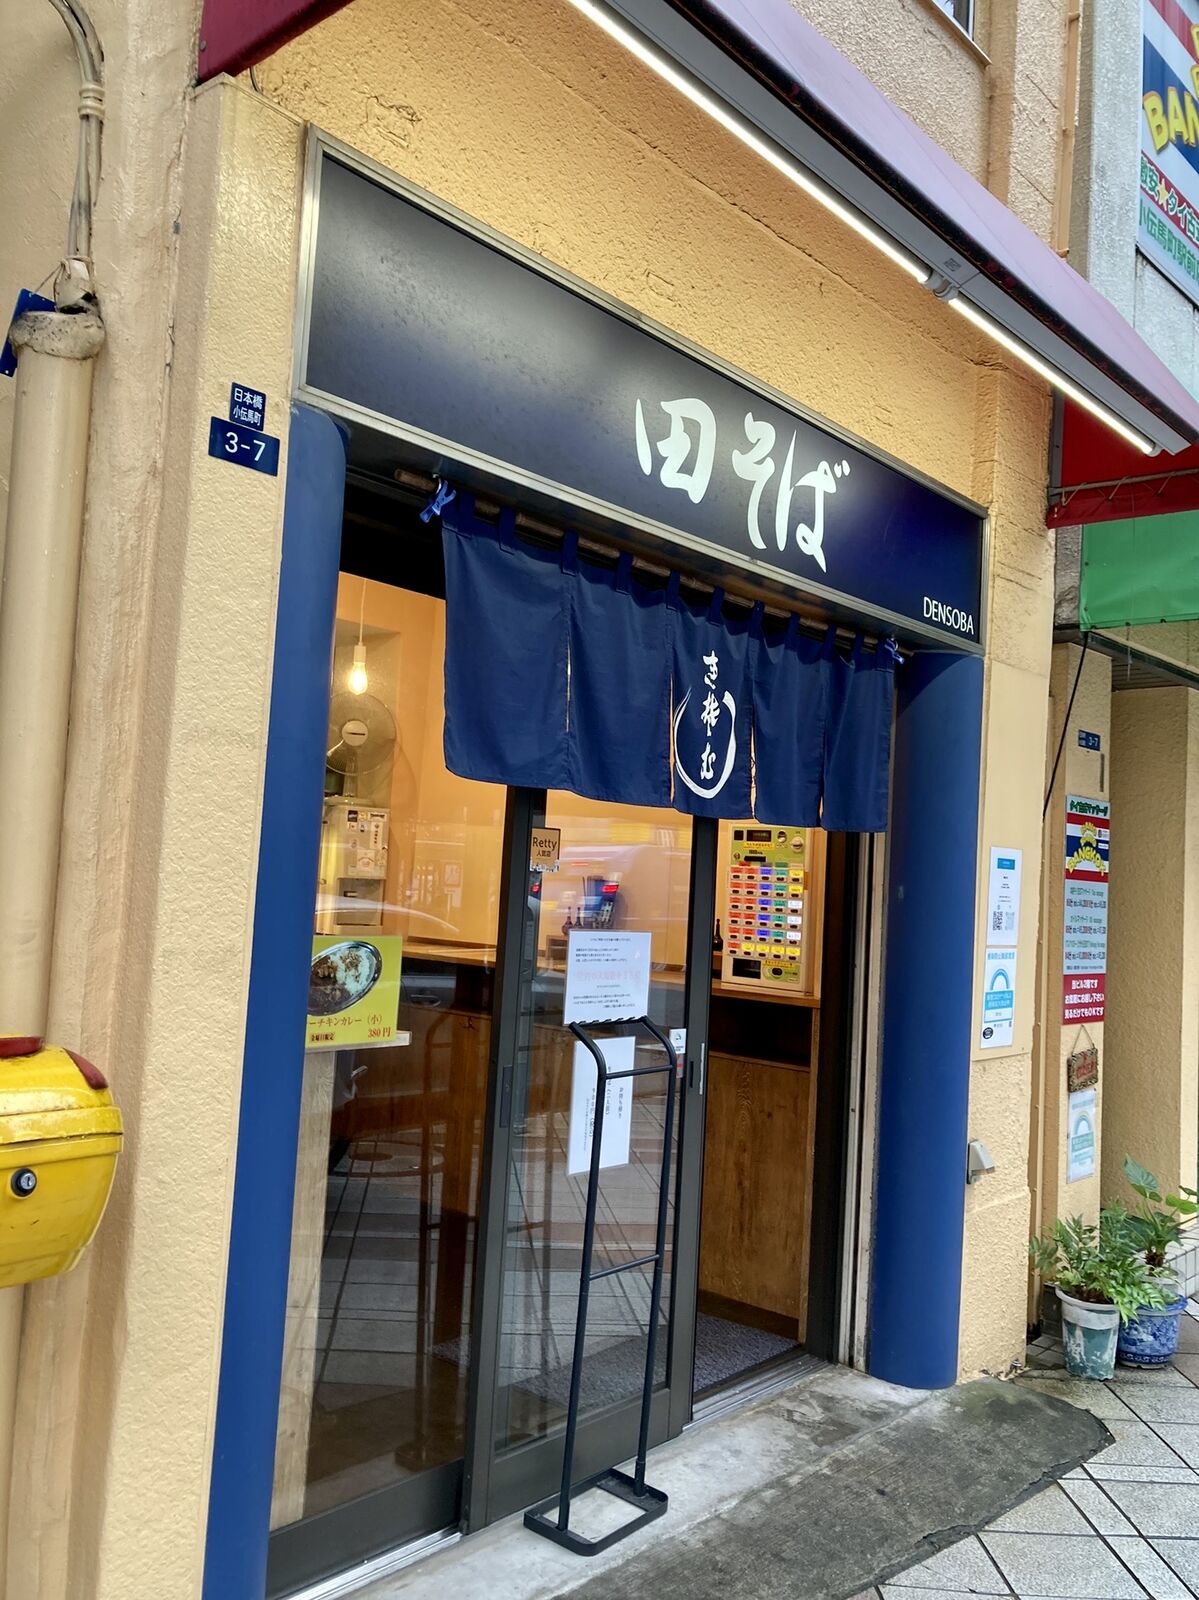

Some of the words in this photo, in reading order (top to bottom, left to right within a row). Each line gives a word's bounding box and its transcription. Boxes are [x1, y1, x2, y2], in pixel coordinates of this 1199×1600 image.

[234, 387, 263, 410] 日本橋
[232, 404, 262, 426] 小伝馬町
[225, 431, 266, 462] 3-7
[635, 397, 850, 573] 田そば
[923, 597, 974, 635] DENSOBA
[532, 836, 558, 851] Retty
[367, 1026, 391, 1038] 380円
